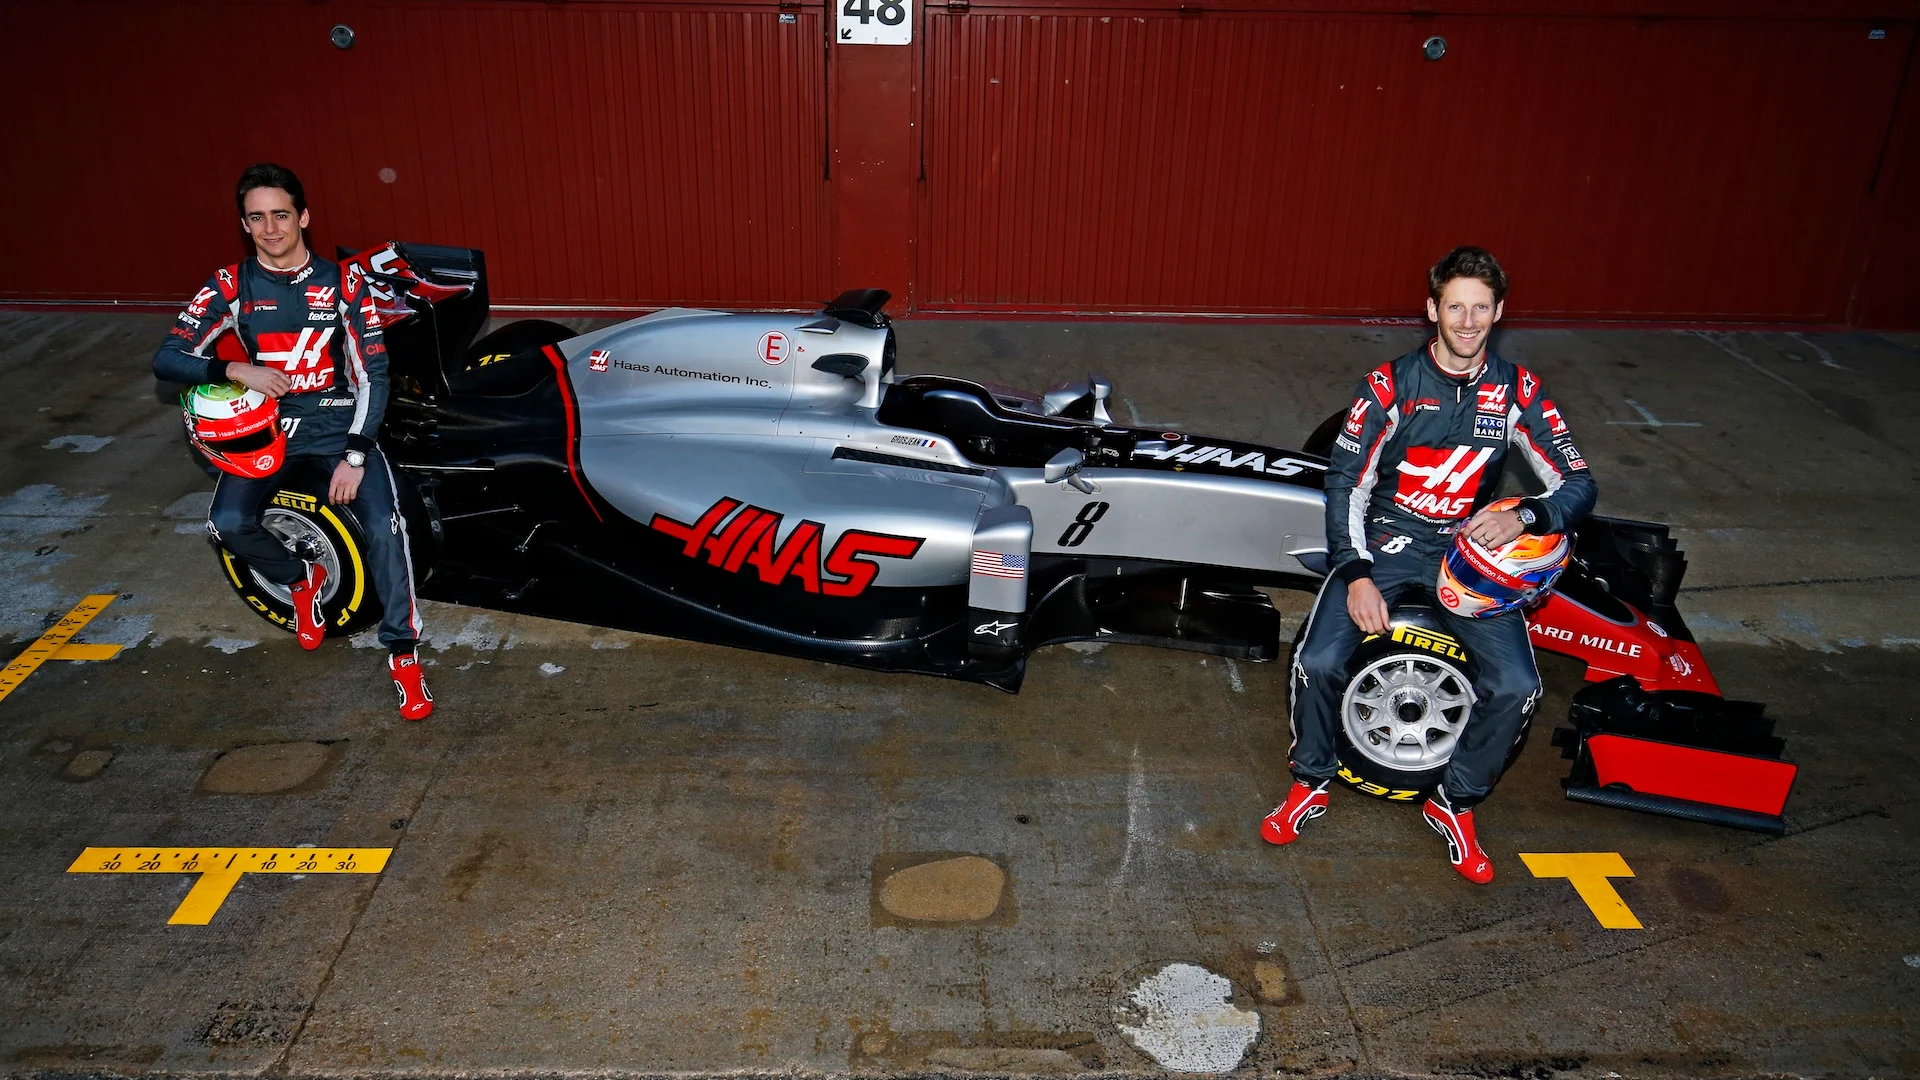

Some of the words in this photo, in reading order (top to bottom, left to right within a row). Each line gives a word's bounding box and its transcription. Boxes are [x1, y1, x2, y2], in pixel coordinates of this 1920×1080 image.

[843, 0, 906, 26] 48
[308, 311, 337, 321] telcel
[366, 343, 386, 356] Cla
[766, 335, 782, 361] E
[613, 359, 650, 373] Haas
[653, 364, 741, 385] Automation
[745, 376, 772, 389] Inc.
[1475, 428, 1503, 437] BANK
[1477, 417, 1503, 428] SAXO
[1134, 443, 1330, 477] HAAS
[272, 490, 318, 514] RELLI
[1395, 490, 1475, 516] HAAS
[1057, 501, 1110, 547] 8
[651, 495, 927, 597] HAAS
[1464, 548, 1496, 578] Automation
[1391, 624, 1468, 663] PIREL
[1579, 634, 1642, 659] MILLE
[1337, 760, 1420, 801] ZER
[99, 861, 122, 871] 30
[137, 861, 161, 871] 20
[181, 861, 198, 871] 10
[260, 861, 277, 871] 10
[296, 861, 318, 871] 20
[335, 861, 356, 871] 30
